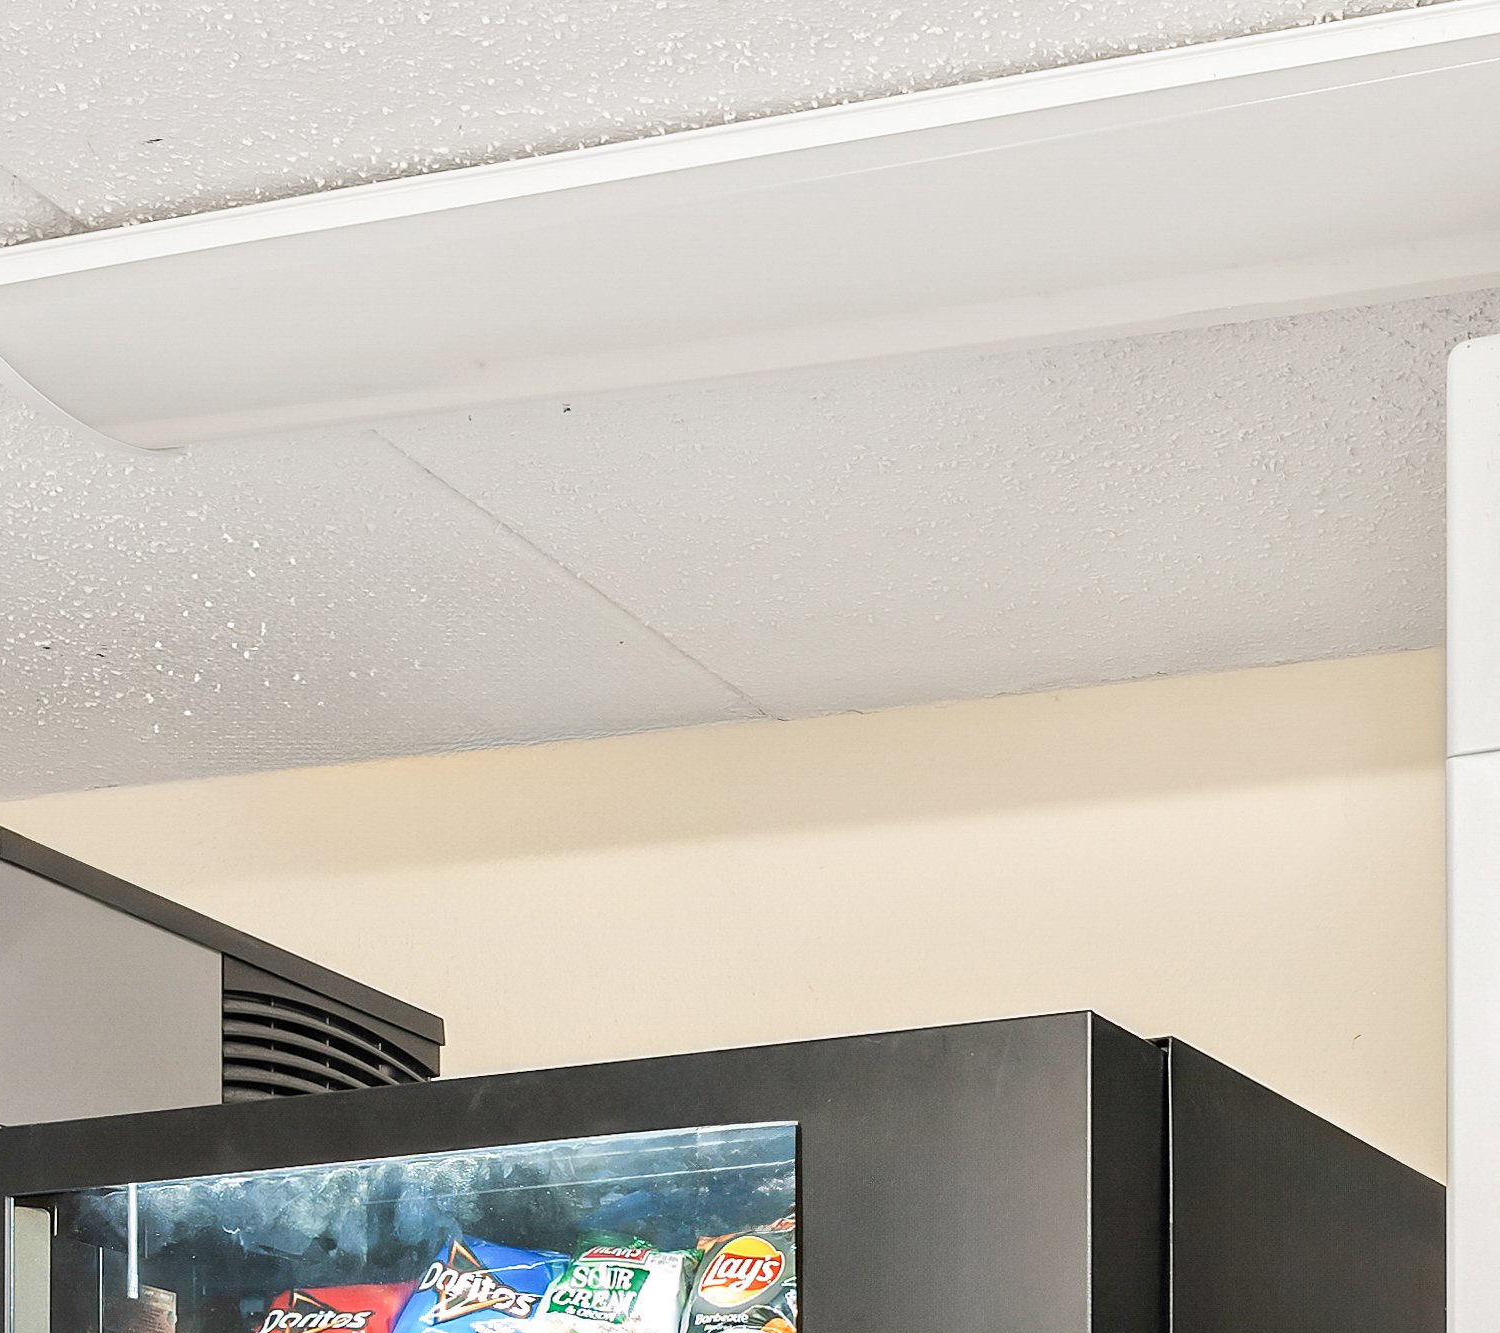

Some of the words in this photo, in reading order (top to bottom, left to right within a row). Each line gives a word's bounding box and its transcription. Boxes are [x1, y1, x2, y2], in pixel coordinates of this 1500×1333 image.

[419, 1261, 534, 1318] Doritos
[571, 1267, 633, 1290] SOUR
[701, 1253, 781, 1290] Lay's
